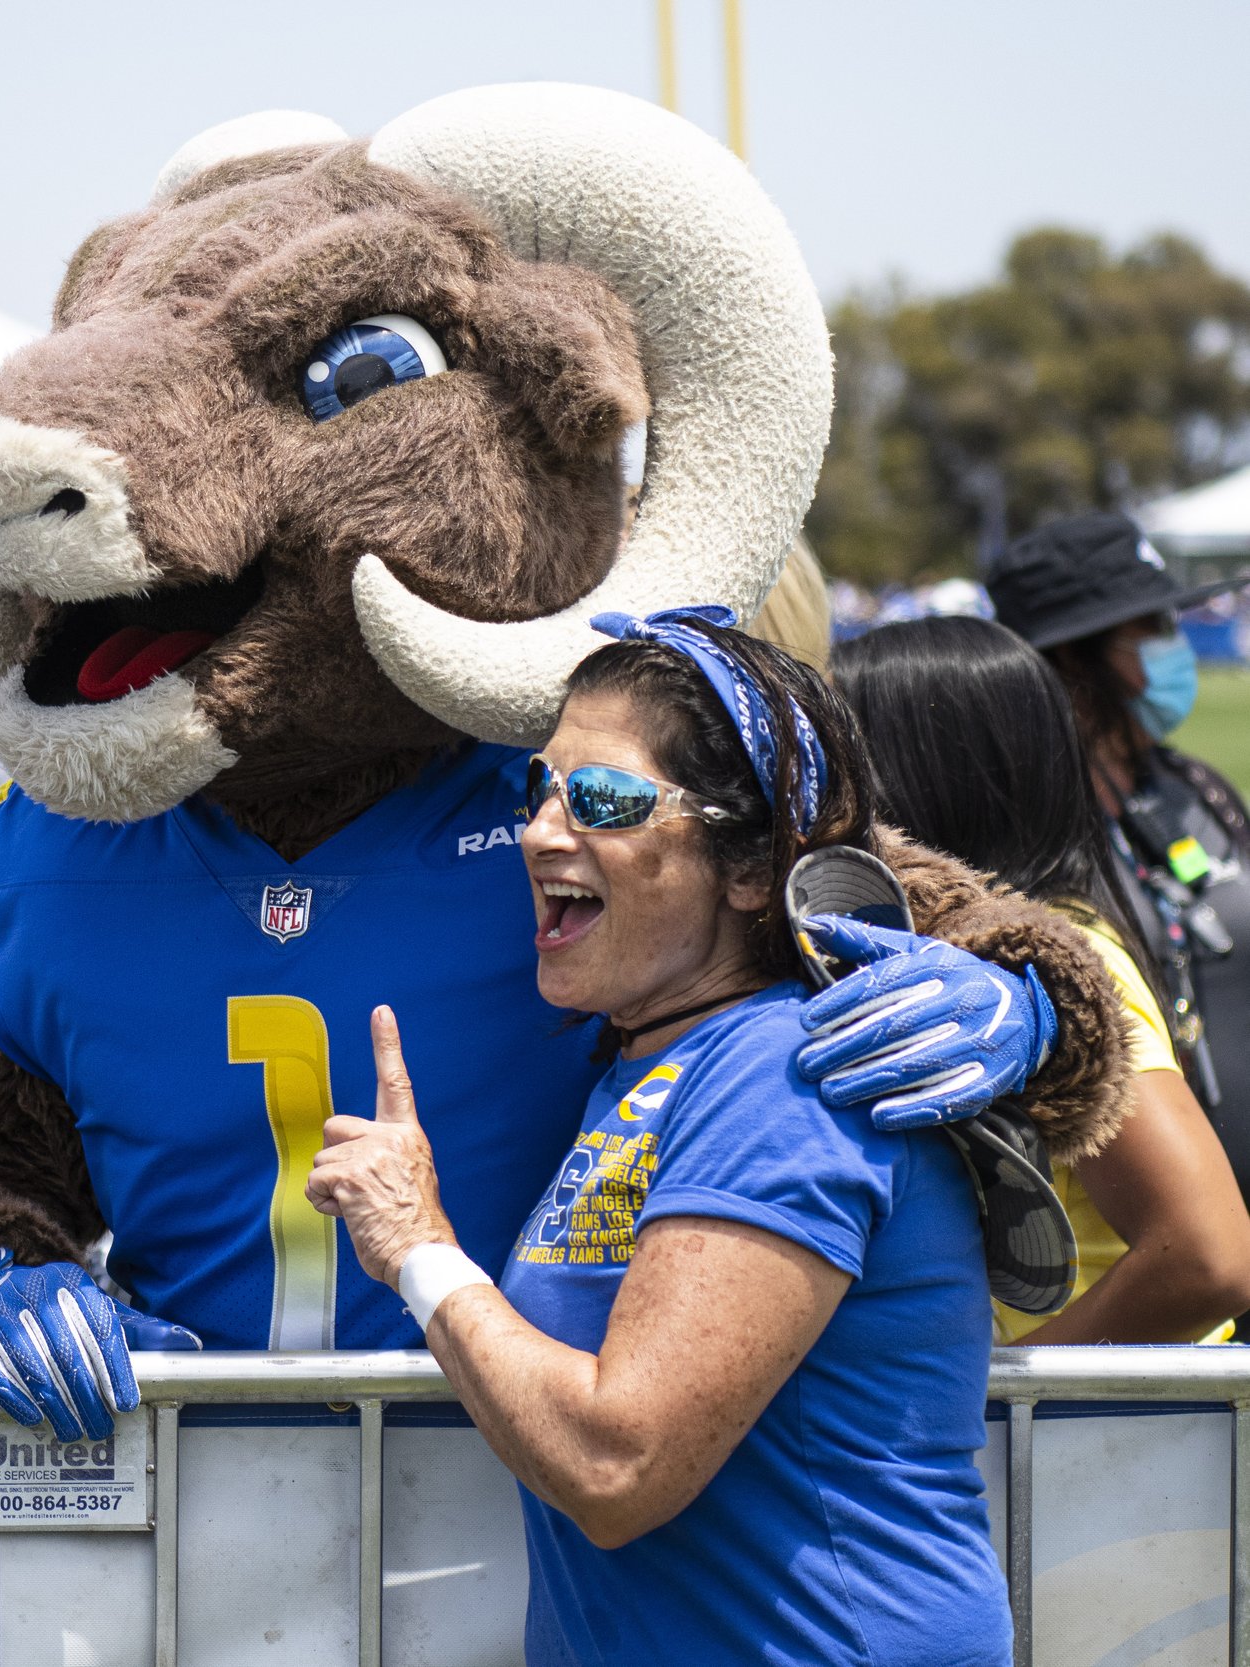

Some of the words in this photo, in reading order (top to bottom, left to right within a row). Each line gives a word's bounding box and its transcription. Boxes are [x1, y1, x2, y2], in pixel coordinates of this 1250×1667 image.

[268, 906, 301, 931] NFL
[638, 1152, 659, 1172] AN
[227, 995, 337, 1350] 1
[571, 1213, 601, 1230] RAMS
[605, 1211, 634, 1228] LOS
[567, 1231, 587, 1247] LOS
[526, 1246, 566, 1264] ANGELES
[568, 1247, 604, 1264] RAMS
[4, 1470, 57, 1480] SERVICES
